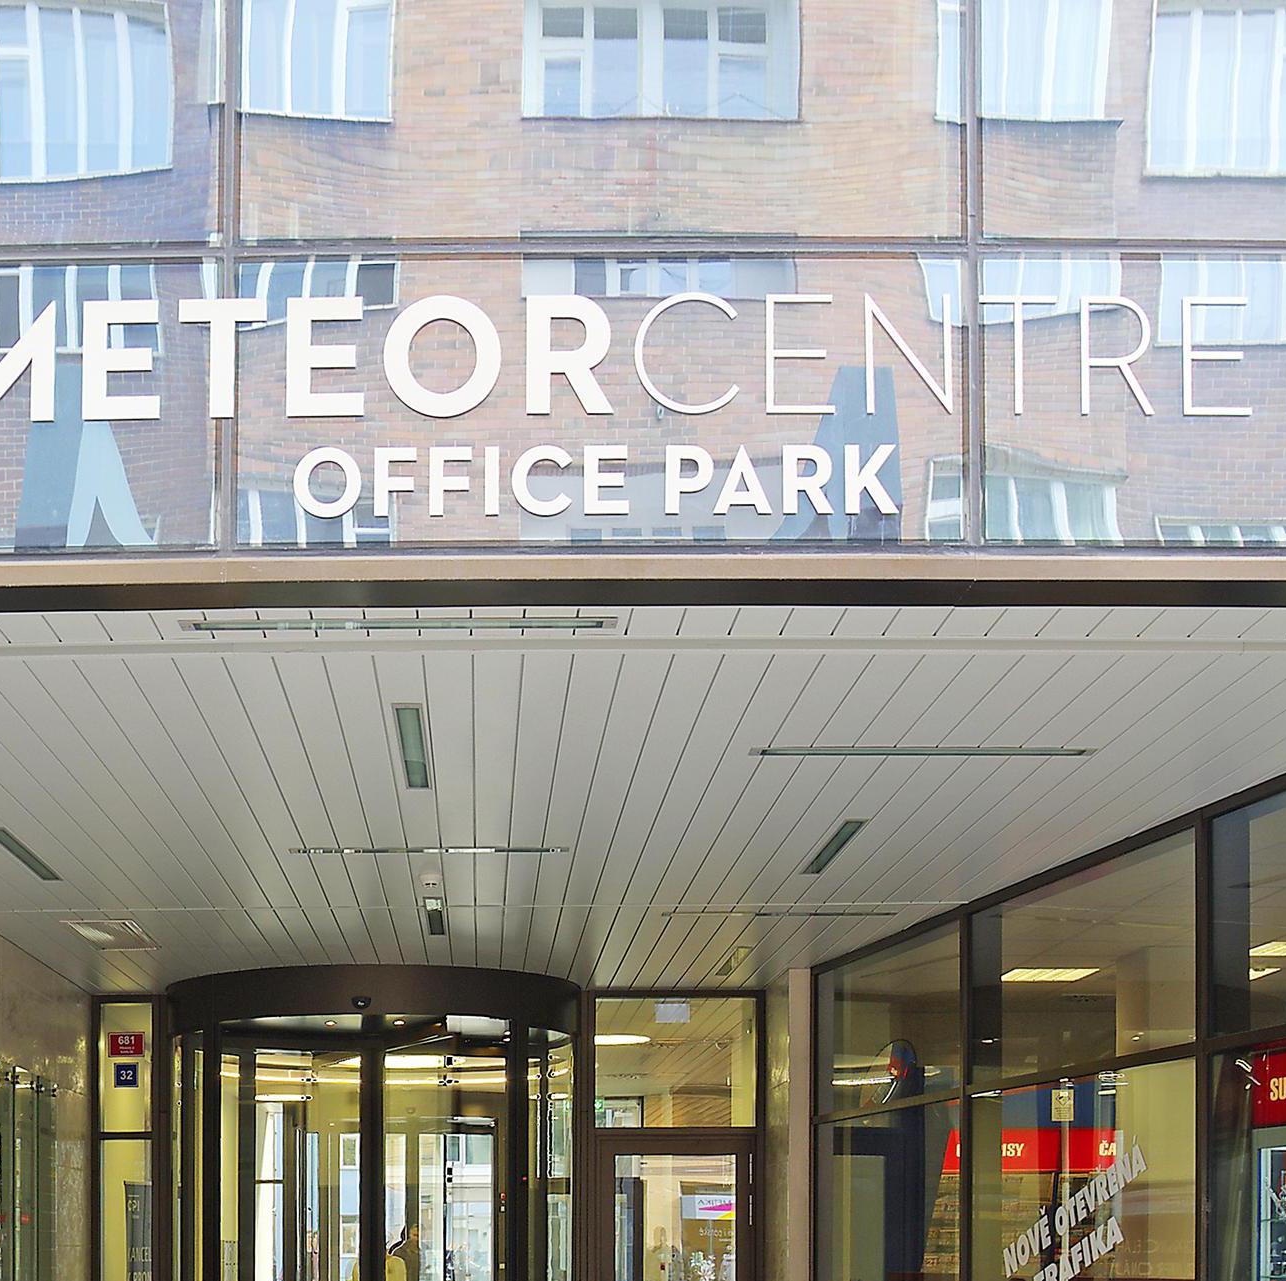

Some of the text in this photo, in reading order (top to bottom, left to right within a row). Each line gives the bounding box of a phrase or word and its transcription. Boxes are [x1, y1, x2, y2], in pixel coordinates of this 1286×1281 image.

[293, 443, 899, 518] OFFICE PARK
[118, 1035, 135, 1045] 681
[120, 1070, 133, 1080] 32
[1003, 1205, 1052, 1279] NOVĚ
[1055, 1135, 1148, 1236] OTEVŘENÁ
